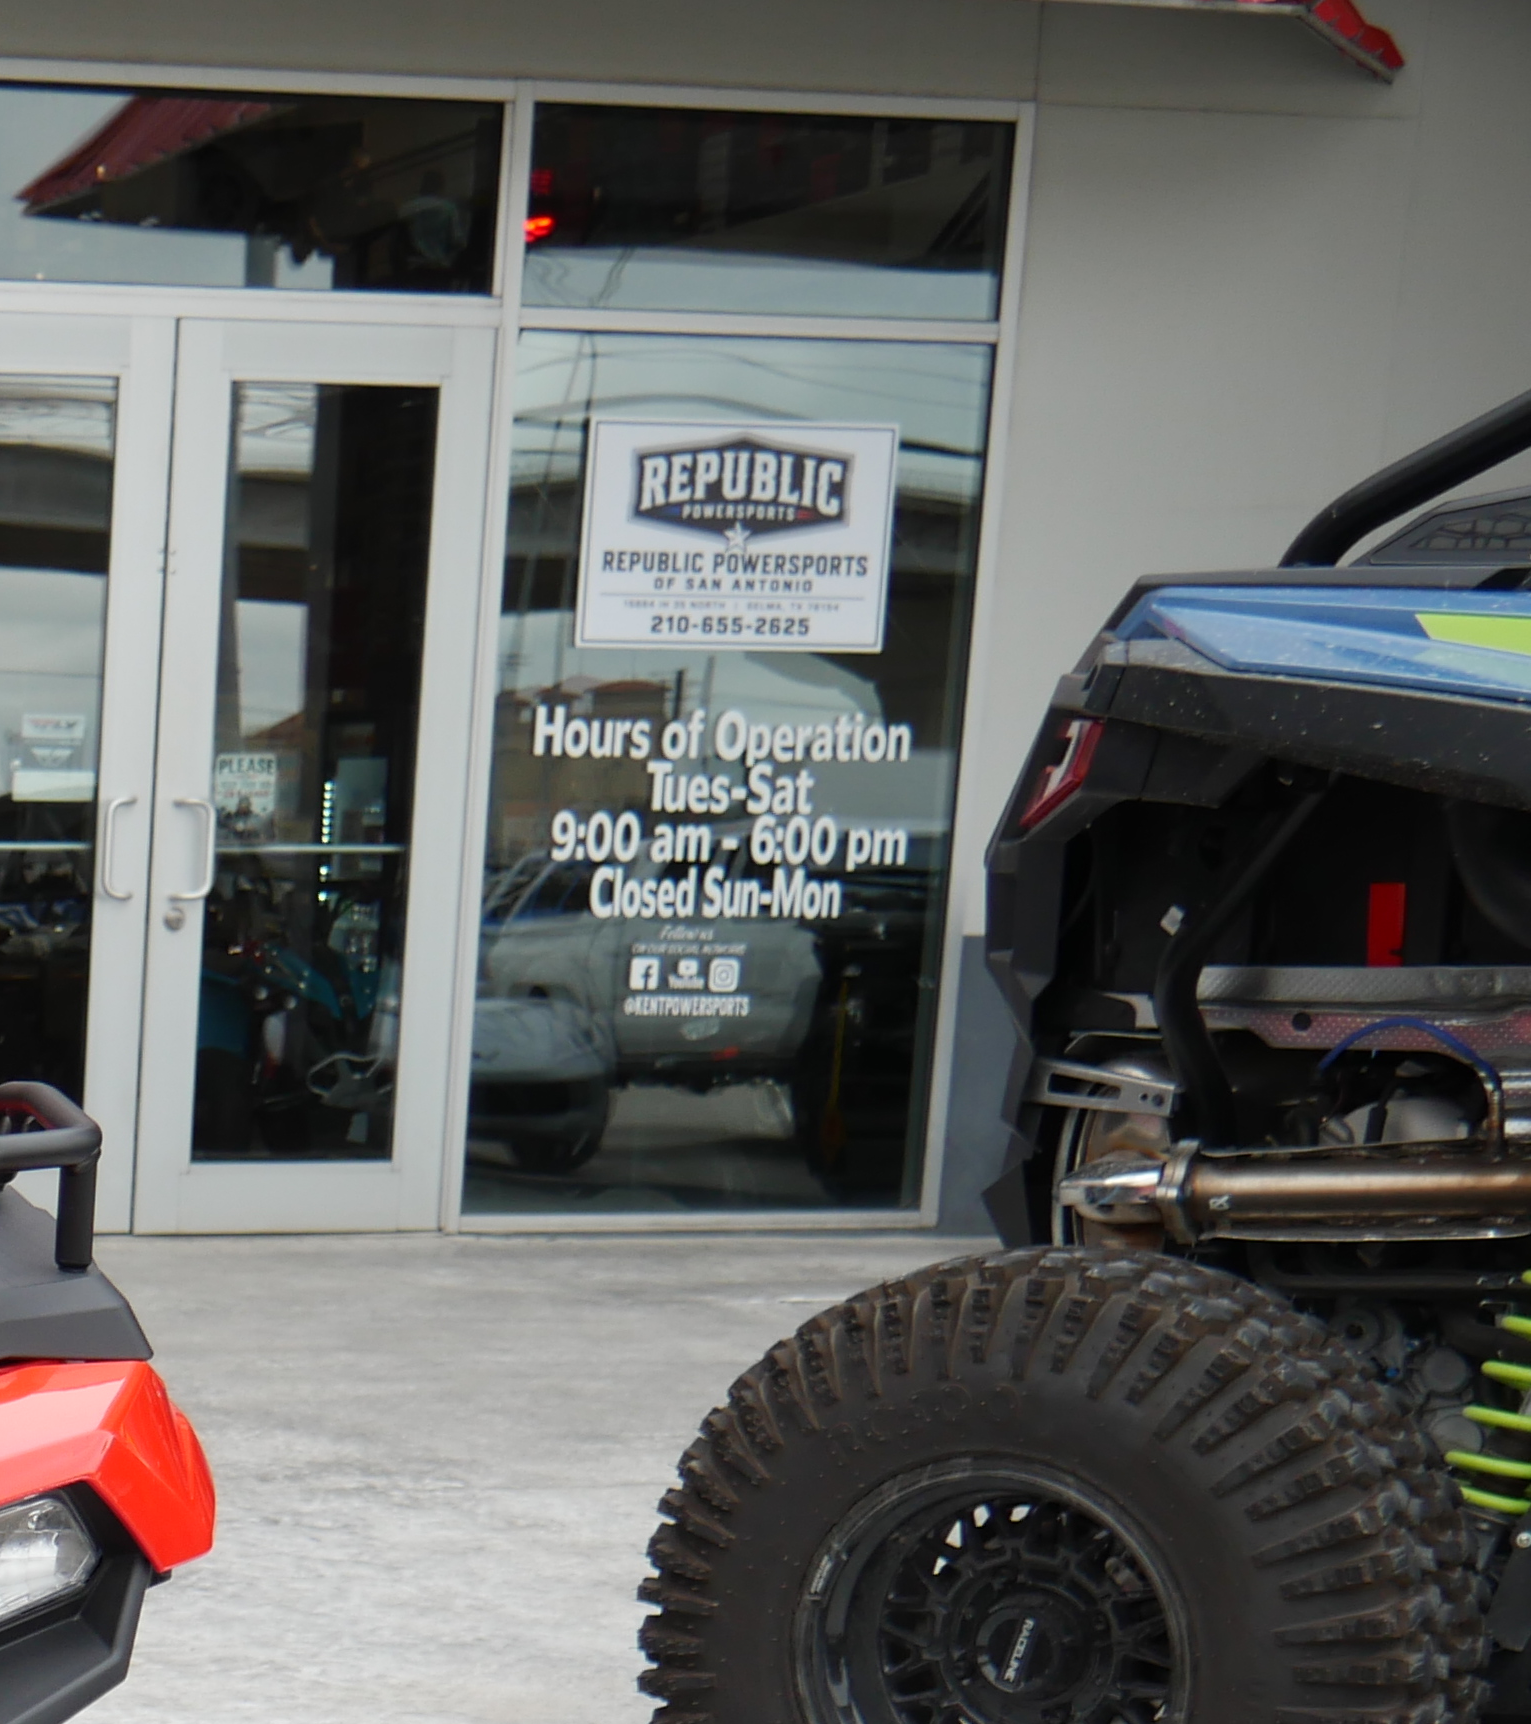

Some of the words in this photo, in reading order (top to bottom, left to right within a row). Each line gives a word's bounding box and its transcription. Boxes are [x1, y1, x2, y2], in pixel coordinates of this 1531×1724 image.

[639, 450, 843, 517] REPUBLIC
[682, 503, 796, 522] POWERSPORTS
[602, 551, 705, 574] REPUBLIC
[712, 552, 869, 577] POWERSPORTS
[653, 577, 675, 590] OF
[685, 578, 722, 591] SAN
[732, 579, 814, 592] ANTONIO
[650, 616, 810, 636] 210-655-2625
[532, 704, 651, 759] Hours
[661, 708, 706, 759] of
[714, 708, 912, 767] Operation
[219, 759, 274, 774] PLEASE
[646, 759, 815, 816] Tues-Sat
[550, 809, 640, 863] 9:00
[650, 822, 711, 864] am
[750, 814, 837, 866] 6:00
[845, 826, 908, 872] pm
[589, 865, 697, 919] Closed
[701, 866, 842, 920] Sun-Mon
[624, 995, 750, 1017] @KENTPOWERSPORTS
